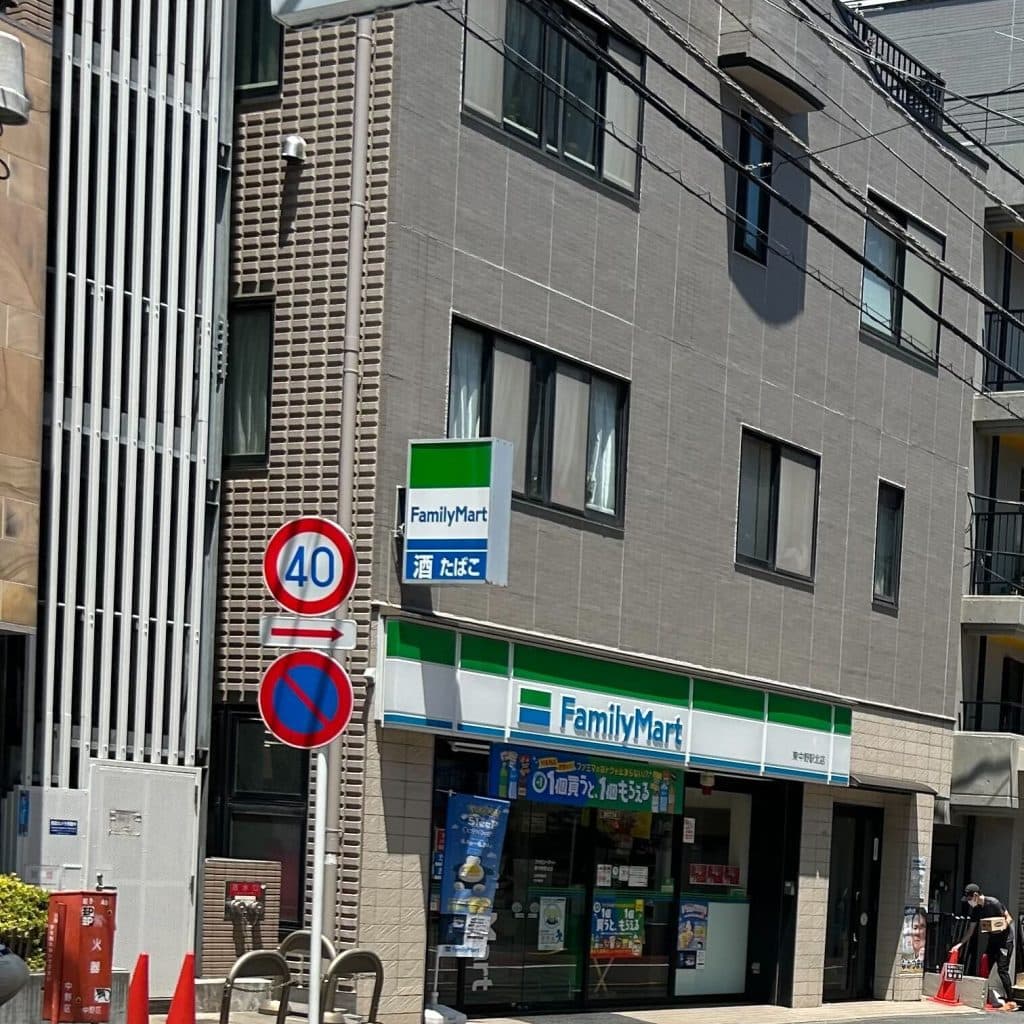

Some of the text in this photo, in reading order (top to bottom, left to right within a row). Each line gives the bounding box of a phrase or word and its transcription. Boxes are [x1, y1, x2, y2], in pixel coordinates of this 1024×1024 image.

[410, 506, 488, 526] FamilyMart
[284, 546, 335, 588] 40
[412, 554, 480, 580] 酒 たばこ
[561, 694, 683, 746] FamilyMart
